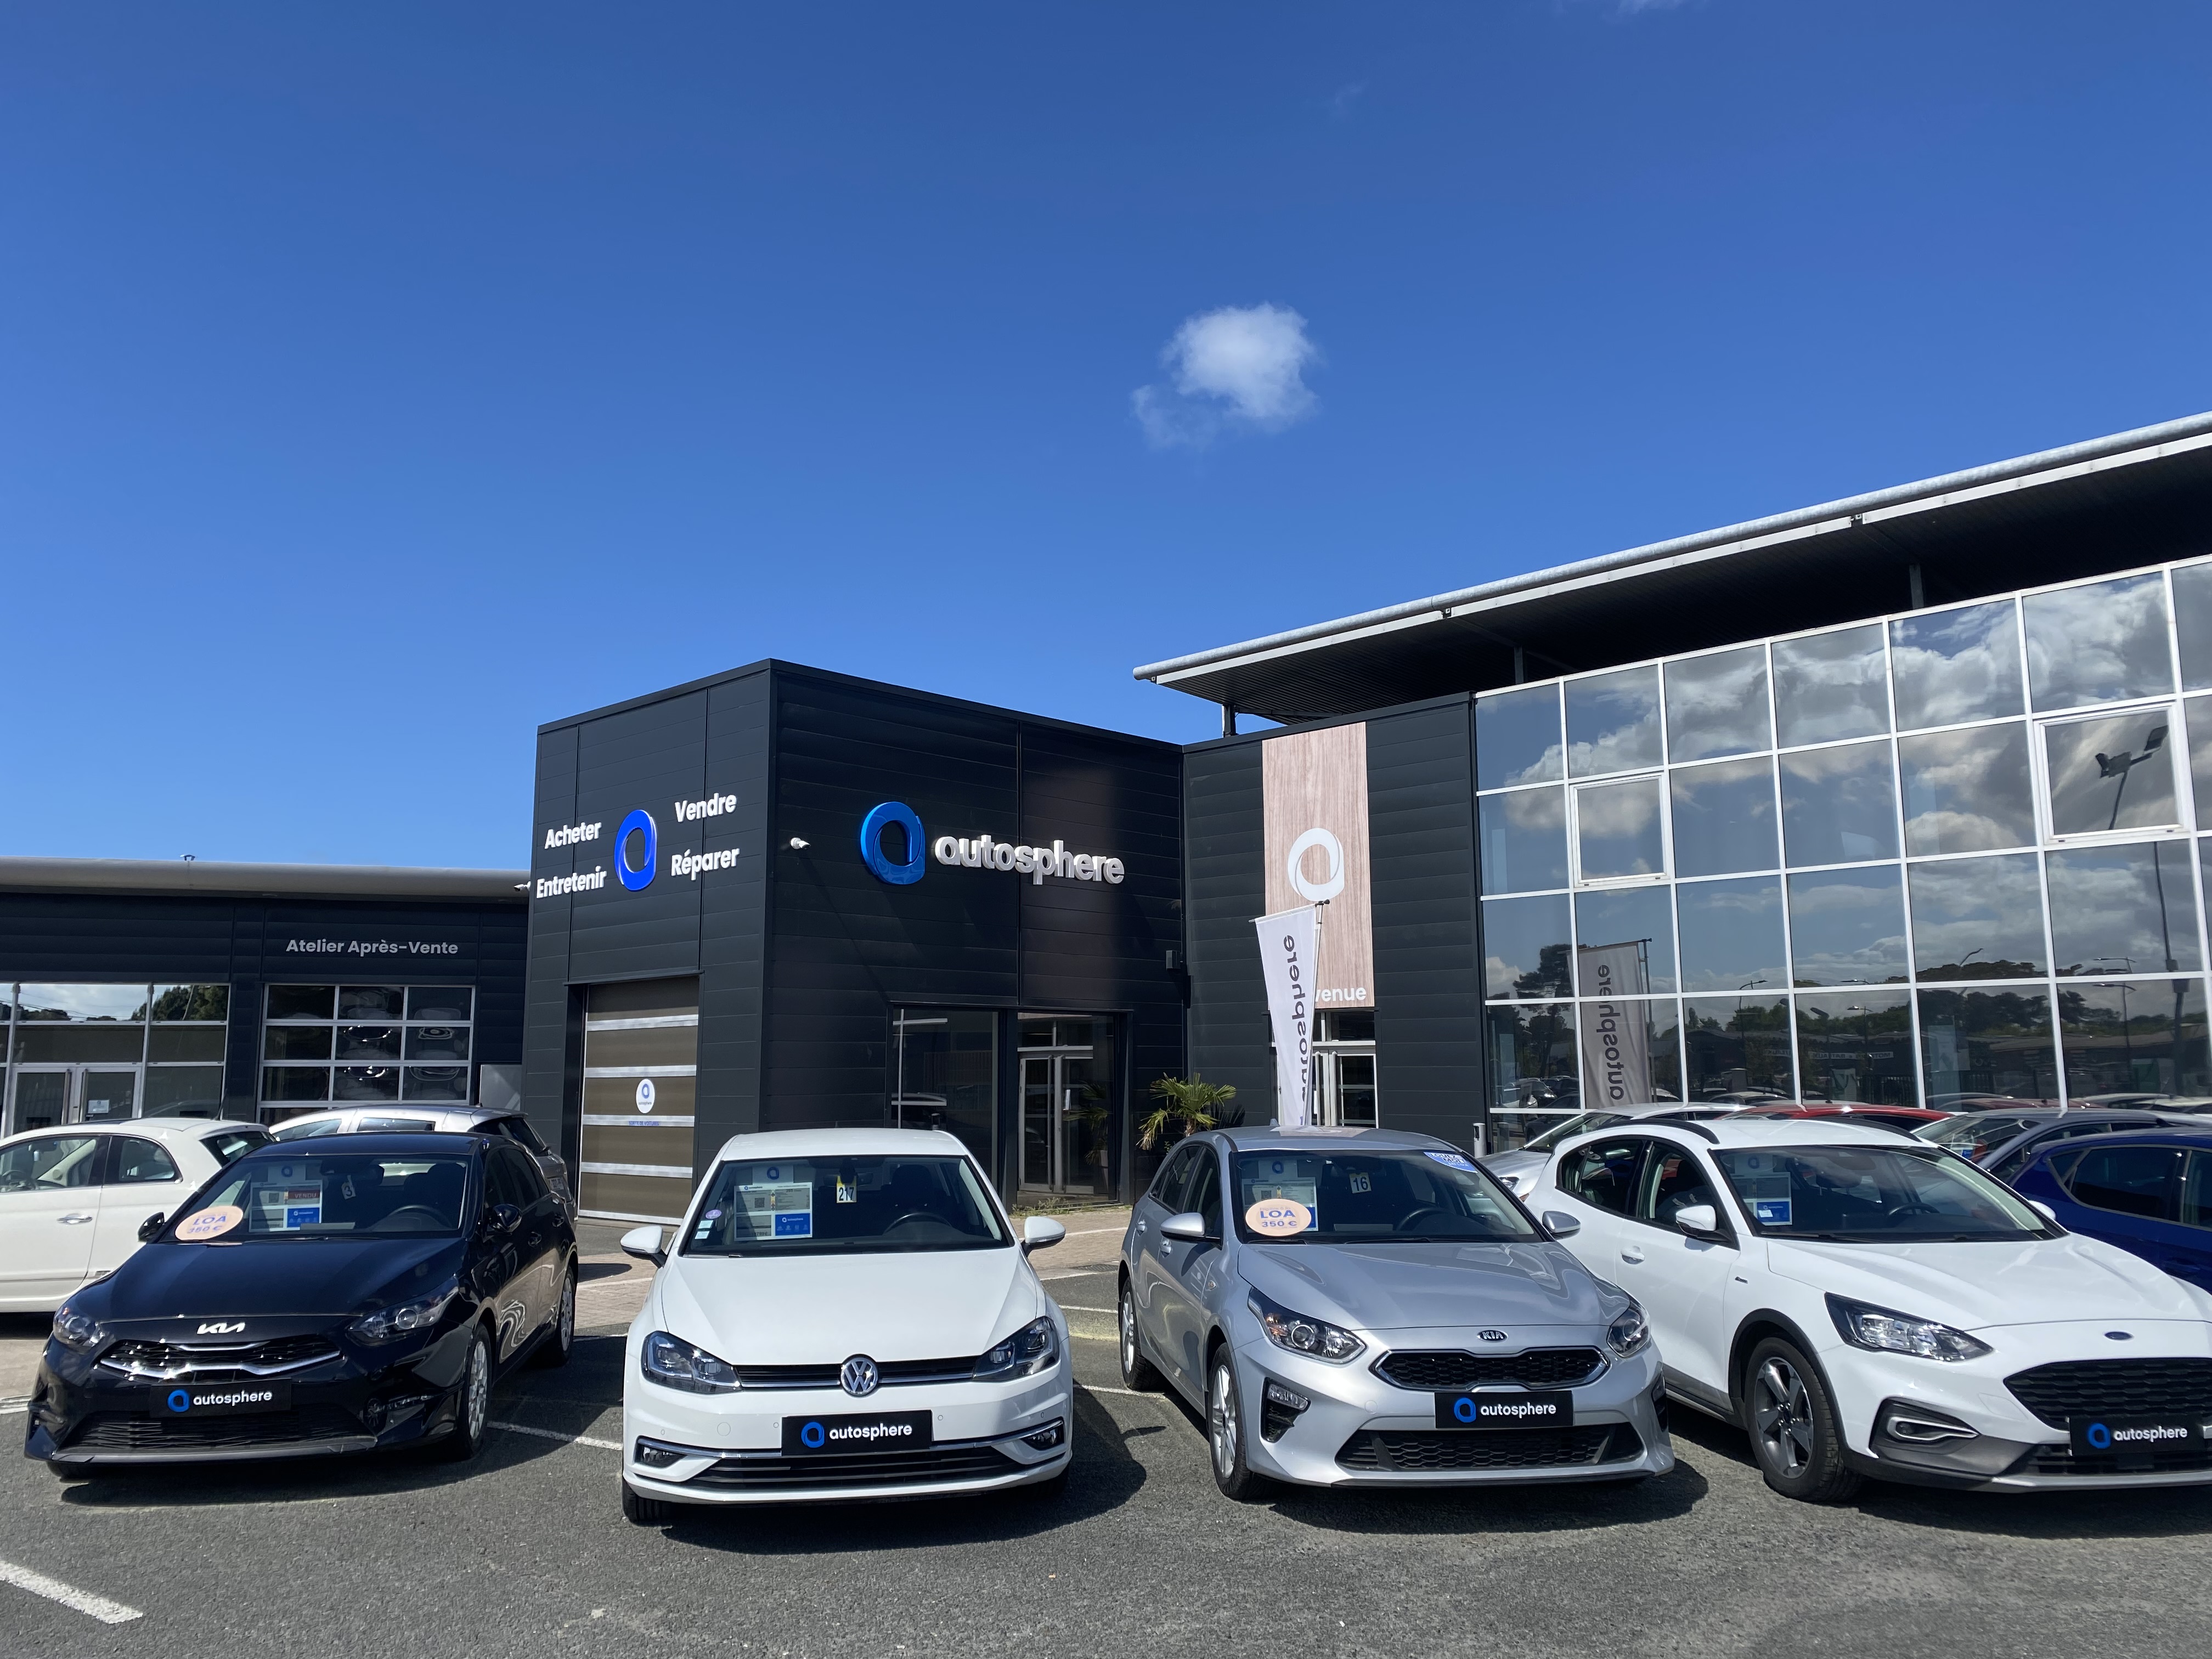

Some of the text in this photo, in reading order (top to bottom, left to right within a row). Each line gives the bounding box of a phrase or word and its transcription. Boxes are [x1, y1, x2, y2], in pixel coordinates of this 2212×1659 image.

[675, 793, 737, 822] Vendre
[544, 822, 601, 849] Acheter
[671, 848, 740, 881] Réparer
[935, 835, 1124, 885] autosphere
[536, 866, 607, 899] Entretenir
[286, 939, 458, 957] Atelier Après-Vente
[344, 1185, 353, 1197] 3
[1353, 1176, 1368, 1191] 16
[839, 1187, 854, 1201] 217
[193, 1216, 226, 1225] LOA
[1260, 1210, 1295, 1218] LOA
[1482, 1331, 1504, 1340] KIA
[194, 1390, 273, 1406] autosphere
[1481, 1402, 1556, 1419] autosphere
[830, 1423, 912, 1441] autosphere
[2114, 1426, 2187, 1442] autosphere
